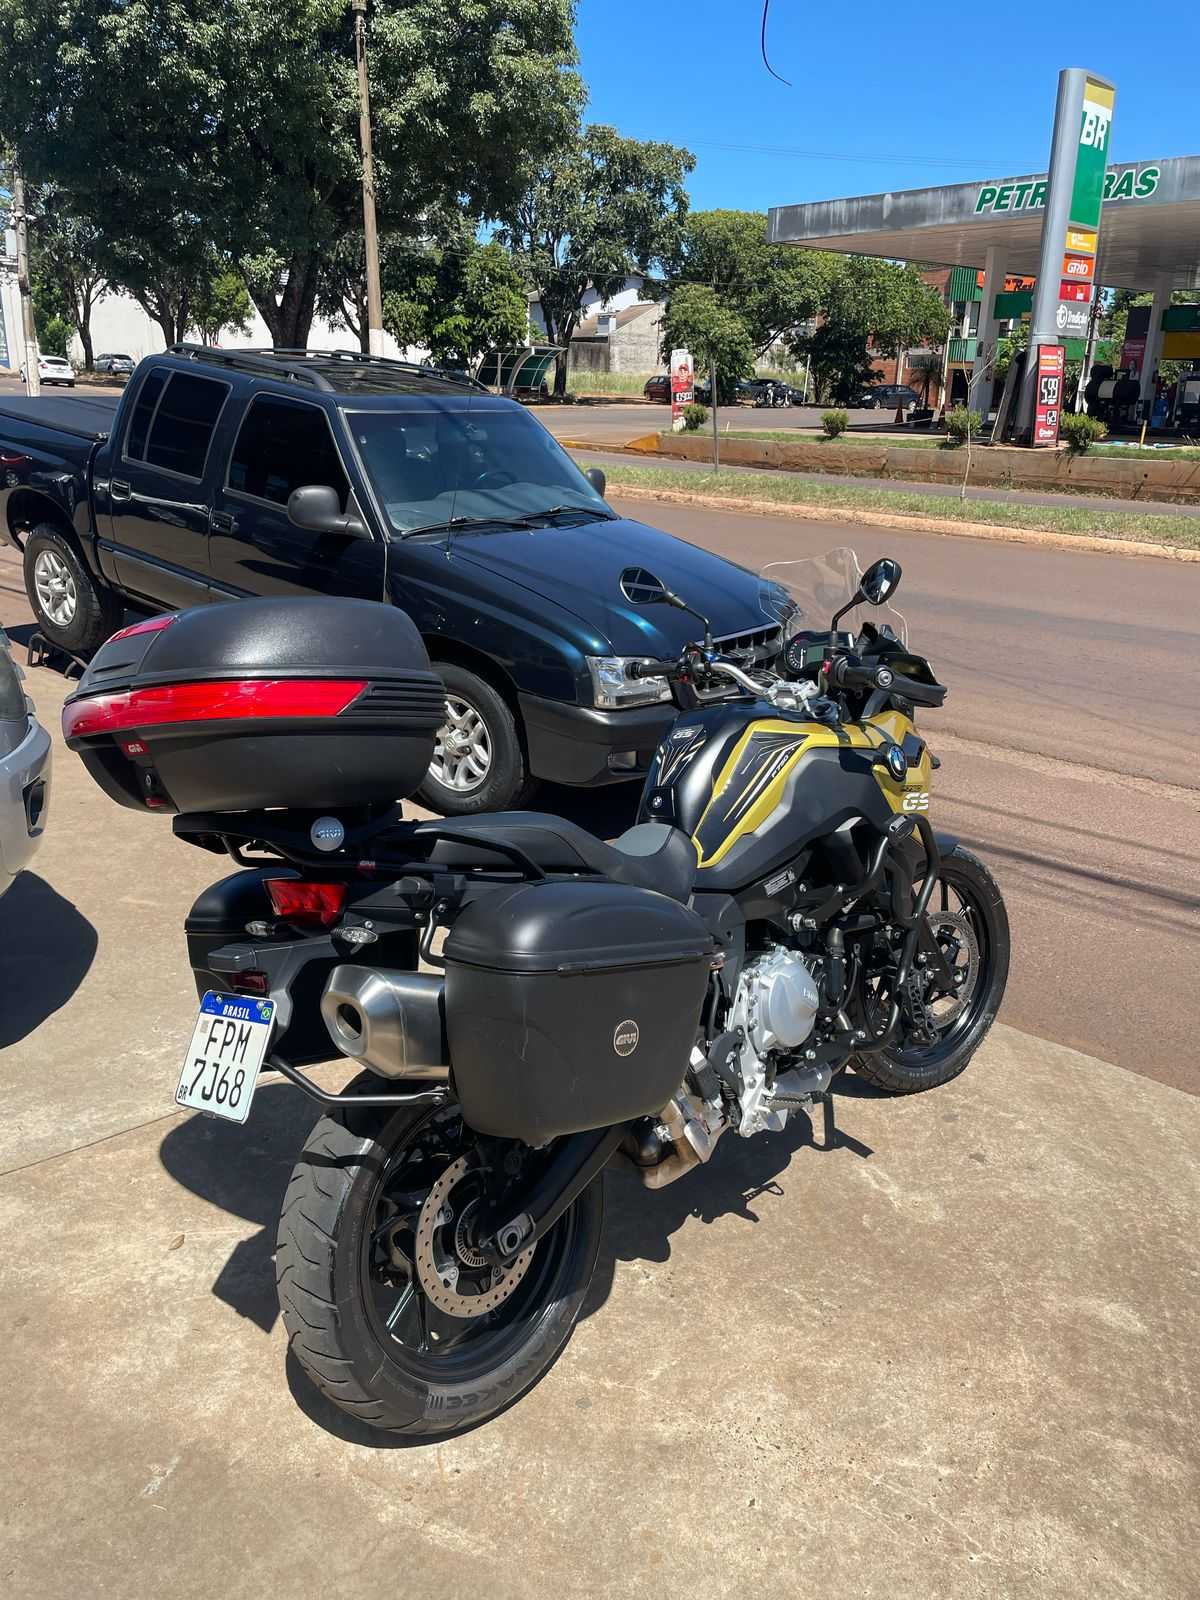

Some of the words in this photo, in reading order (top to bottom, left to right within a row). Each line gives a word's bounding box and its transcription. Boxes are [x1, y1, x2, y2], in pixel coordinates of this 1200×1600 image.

[1080, 110, 1108, 150] BR
[1067, 262, 1089, 275] GRID
[223, 1004, 250, 1019] BRASIL
[203, 1018, 253, 1064] FPM
[188, 1057, 246, 1108] 7J68
